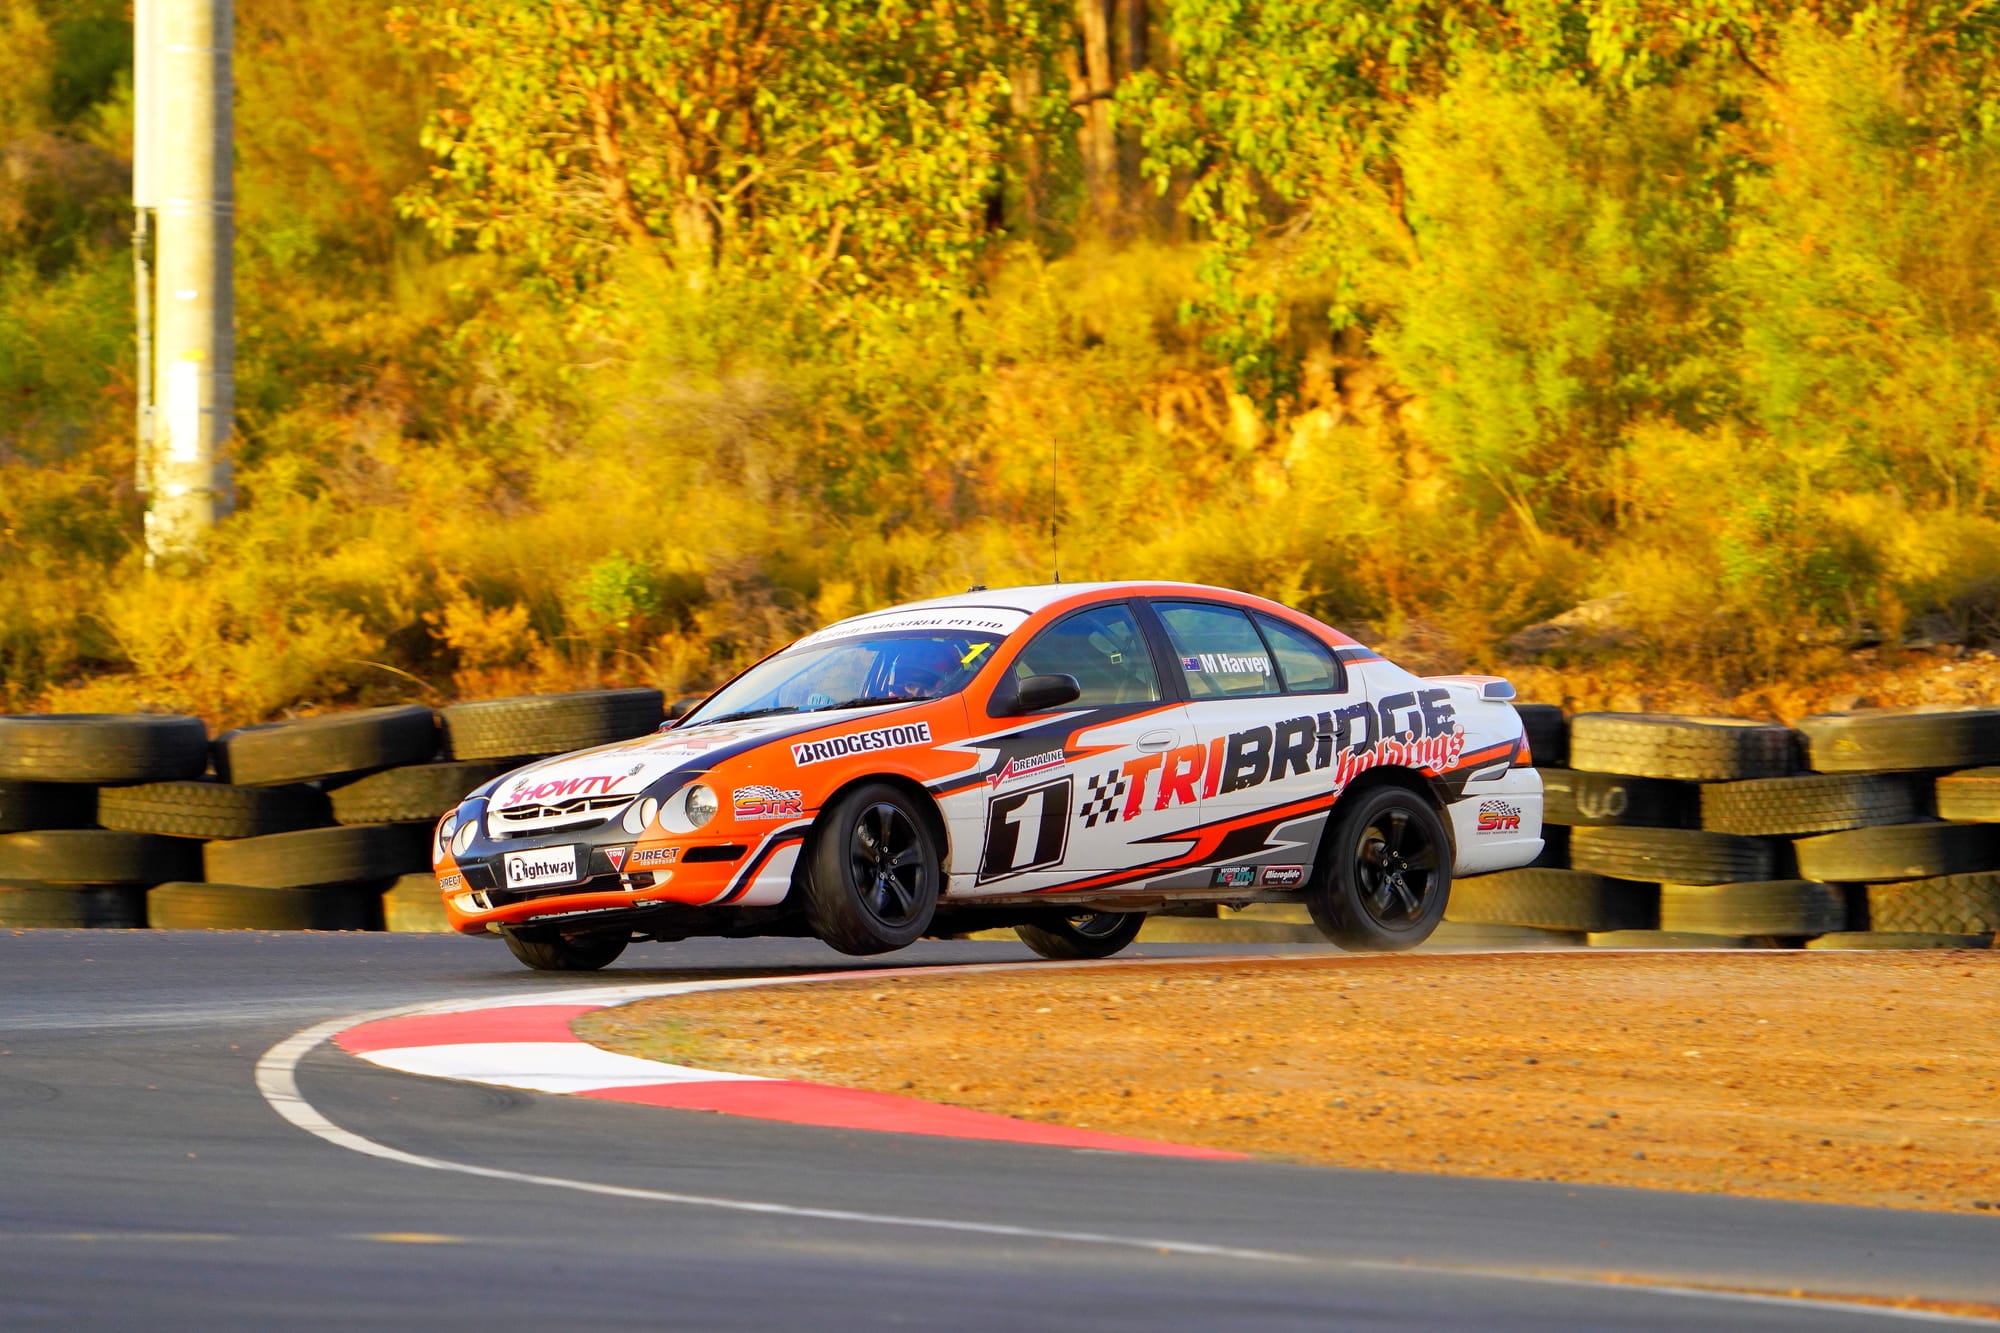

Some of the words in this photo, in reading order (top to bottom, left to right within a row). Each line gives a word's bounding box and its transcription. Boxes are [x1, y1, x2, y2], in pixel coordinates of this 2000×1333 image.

[947, 618, 977, 626] PTY
[975, 619, 1003, 629] LTD
[961, 642, 990, 664] 1
[1200, 654, 1219, 673] M
[1217, 654, 1270, 676] Harvey
[793, 723, 931, 765] BRIDGESTONE
[1122, 688, 1456, 822] TRIBRIDGE
[986, 749, 1065, 791] ADRENALINE
[502, 776, 627, 808] SHOWTV
[735, 797, 802, 816] STR
[1005, 791, 1044, 869] 1
[1477, 812, 1520, 831] STR
[632, 847, 680, 862] DIRECT
[508, 857, 575, 882] Rightway
[1265, 870, 1300, 880] Microglide
